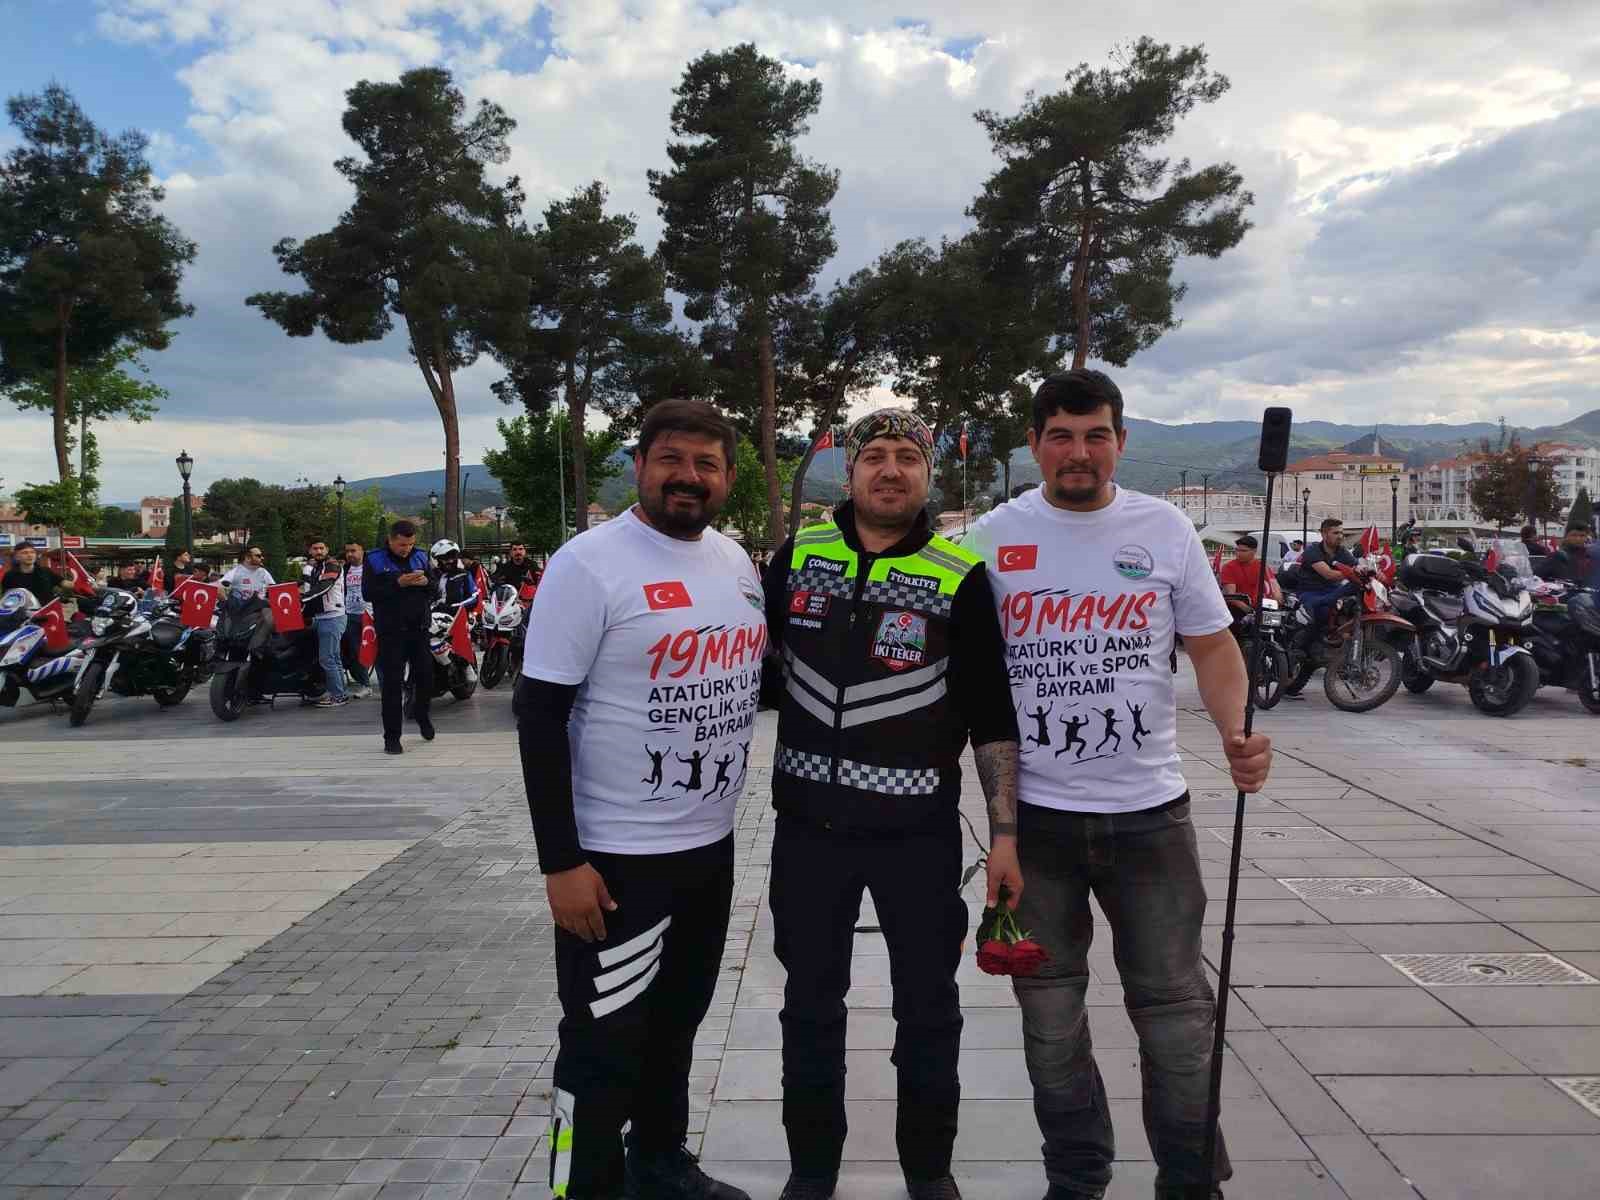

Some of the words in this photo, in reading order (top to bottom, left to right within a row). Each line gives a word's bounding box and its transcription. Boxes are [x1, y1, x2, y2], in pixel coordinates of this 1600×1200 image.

[808, 558, 844, 573] ÇORUM
[889, 570, 938, 591] TÜRKİYE
[1001, 591, 1034, 640] 19
[1035, 591, 1157, 635] MAYIS
[647, 628, 699, 681] 19
[699, 623, 767, 675] MAYI
[890, 646, 922, 664] TEKER
[1008, 657, 1076, 681] GENÇLİK
[1080, 663, 1098, 675] VE
[1102, 653, 1150, 674] SPOR
[648, 670, 748, 703] ATATÜRK'Ü
[1036, 677, 1115, 698] BAYRAMI
[648, 697, 734, 726] GENÇLİK
[736, 700, 748, 713] VE
